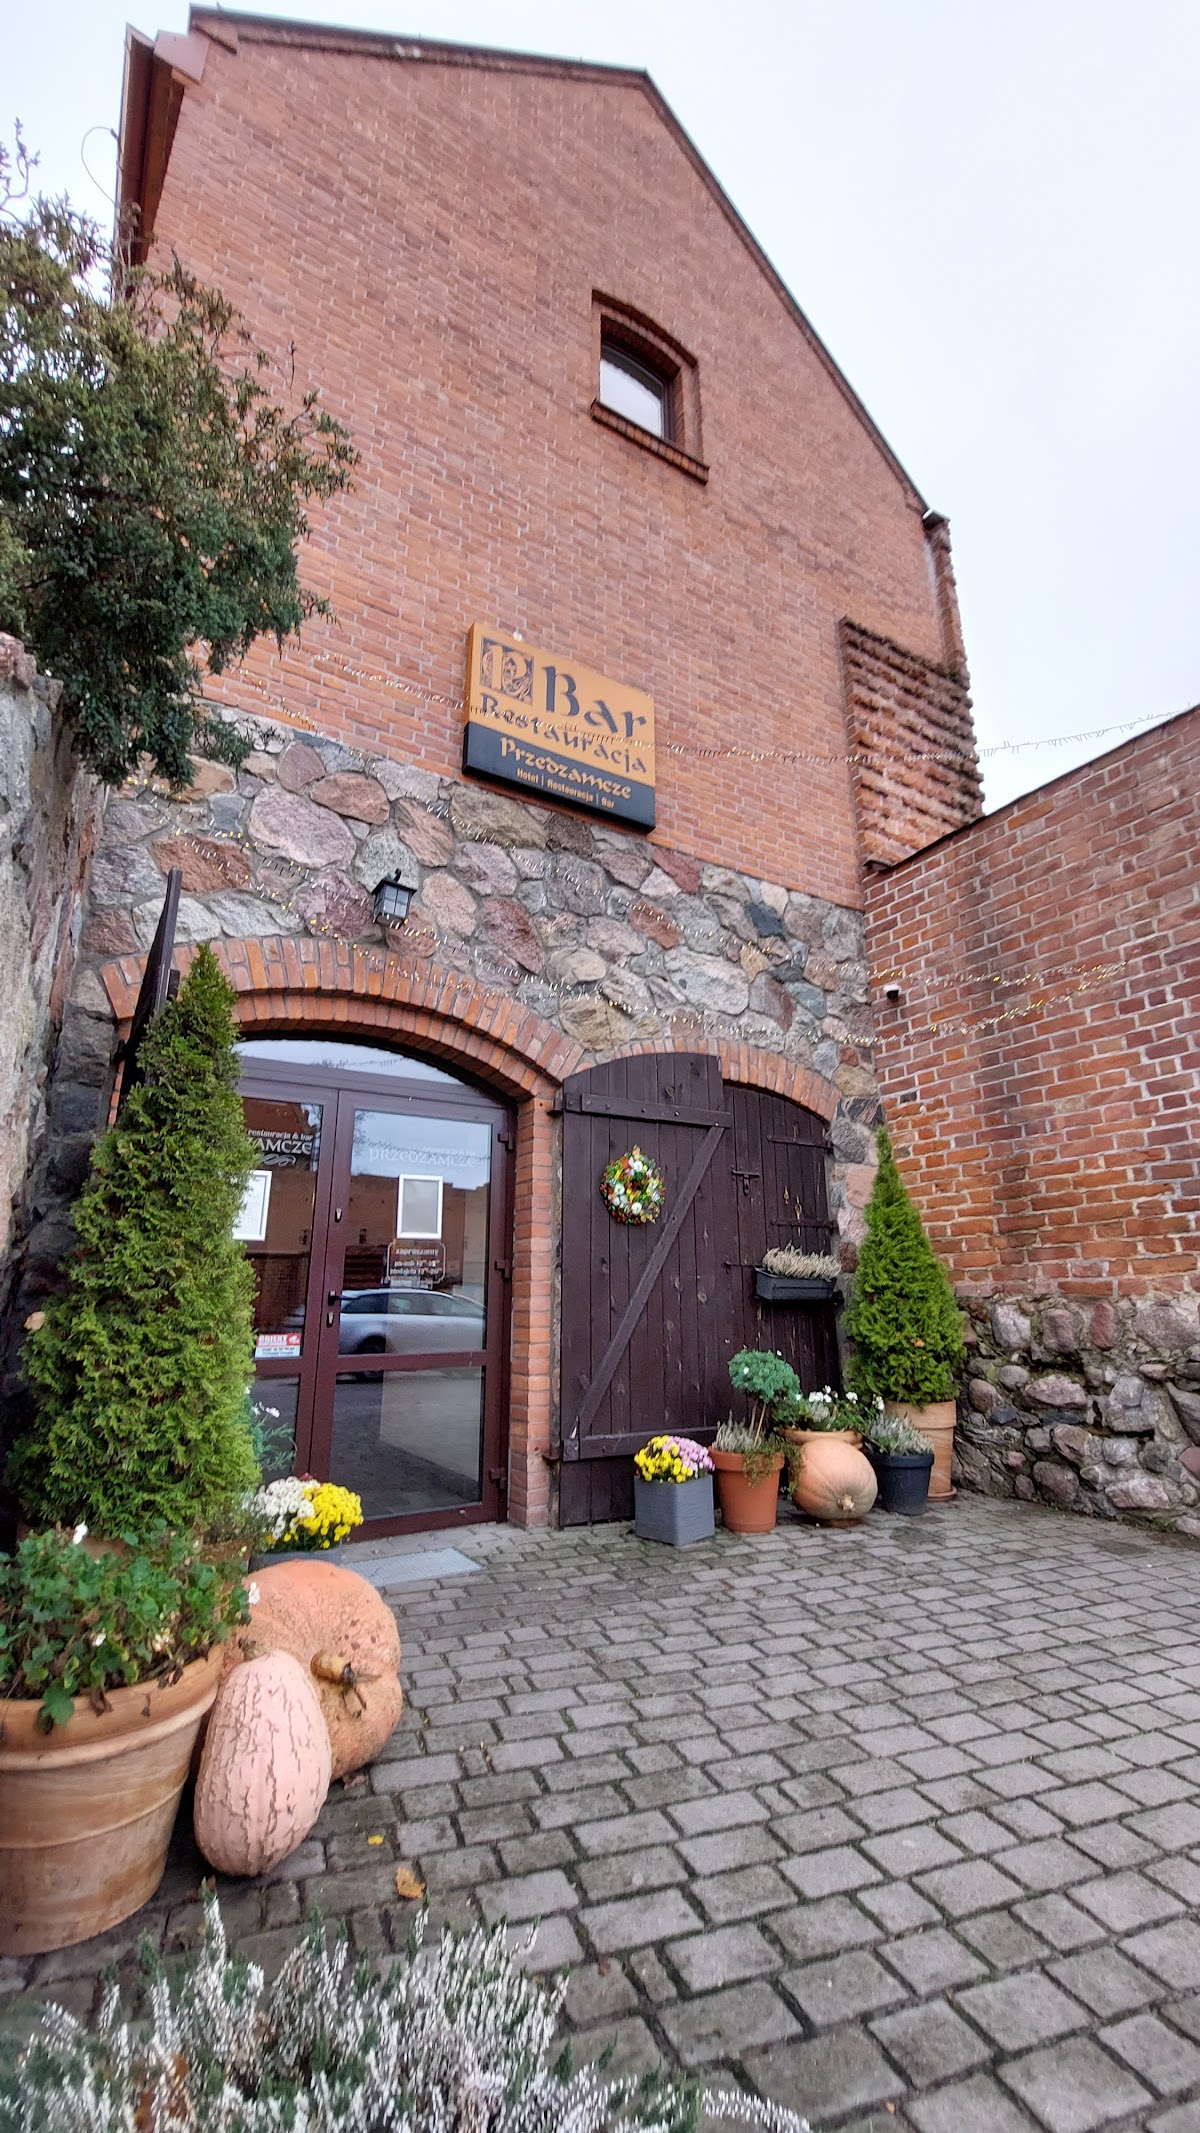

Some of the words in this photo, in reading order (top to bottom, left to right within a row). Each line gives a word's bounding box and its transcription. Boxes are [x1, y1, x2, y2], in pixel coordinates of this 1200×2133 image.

[480, 692, 647, 774] Restauracja
[541, 666, 647, 738] Bar
[499, 737, 632, 799] Przedzamcze
[516, 768, 539, 783] Hotel
[547, 779, 594, 802] Restauracja
[601, 796, 615, 808] Bar
[301, 1133, 314, 1141] bar
